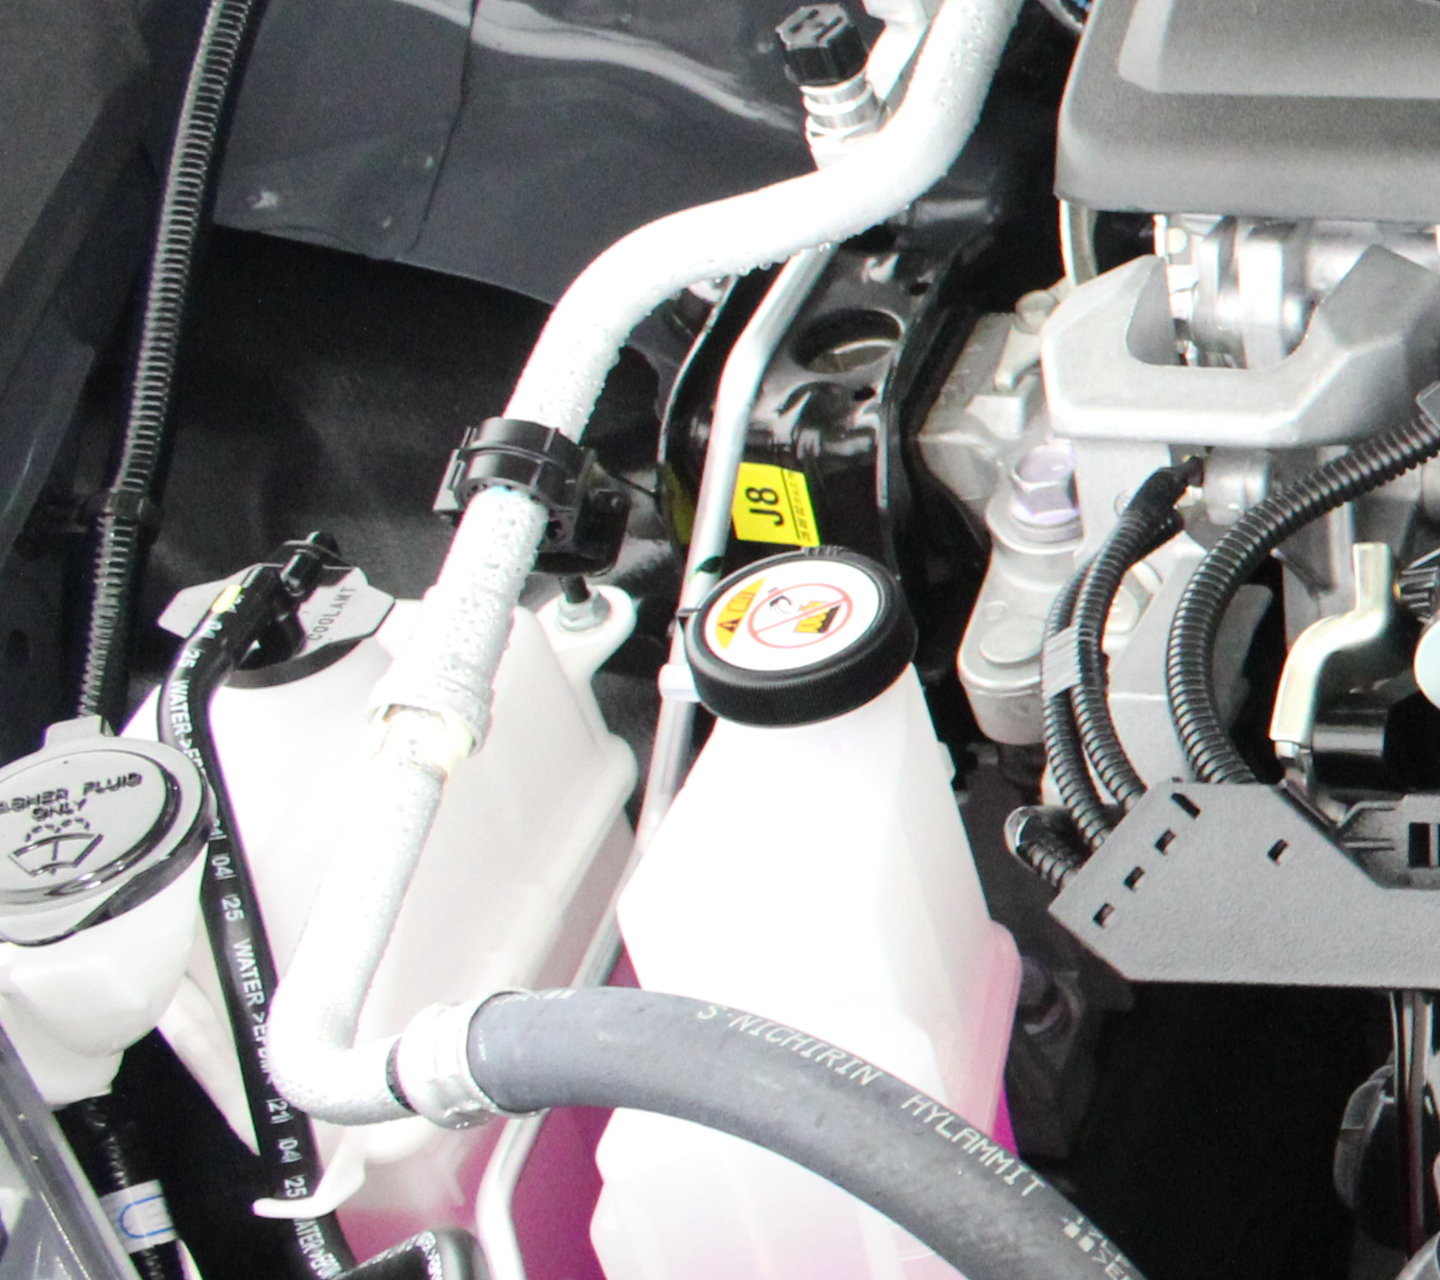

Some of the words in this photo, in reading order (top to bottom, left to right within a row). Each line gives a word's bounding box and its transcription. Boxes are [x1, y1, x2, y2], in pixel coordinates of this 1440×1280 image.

[308, 585, 356, 642] COOLANT
[169, 679, 192, 736] WATER
[32, 798, 87, 821] ONLY
[83, 772, 143, 795] FLUID
[233, 937, 265, 1007] WATER
[900, 1093, 1046, 1198] HYLAMMIT
[294, 1218, 324, 1255] ATER
